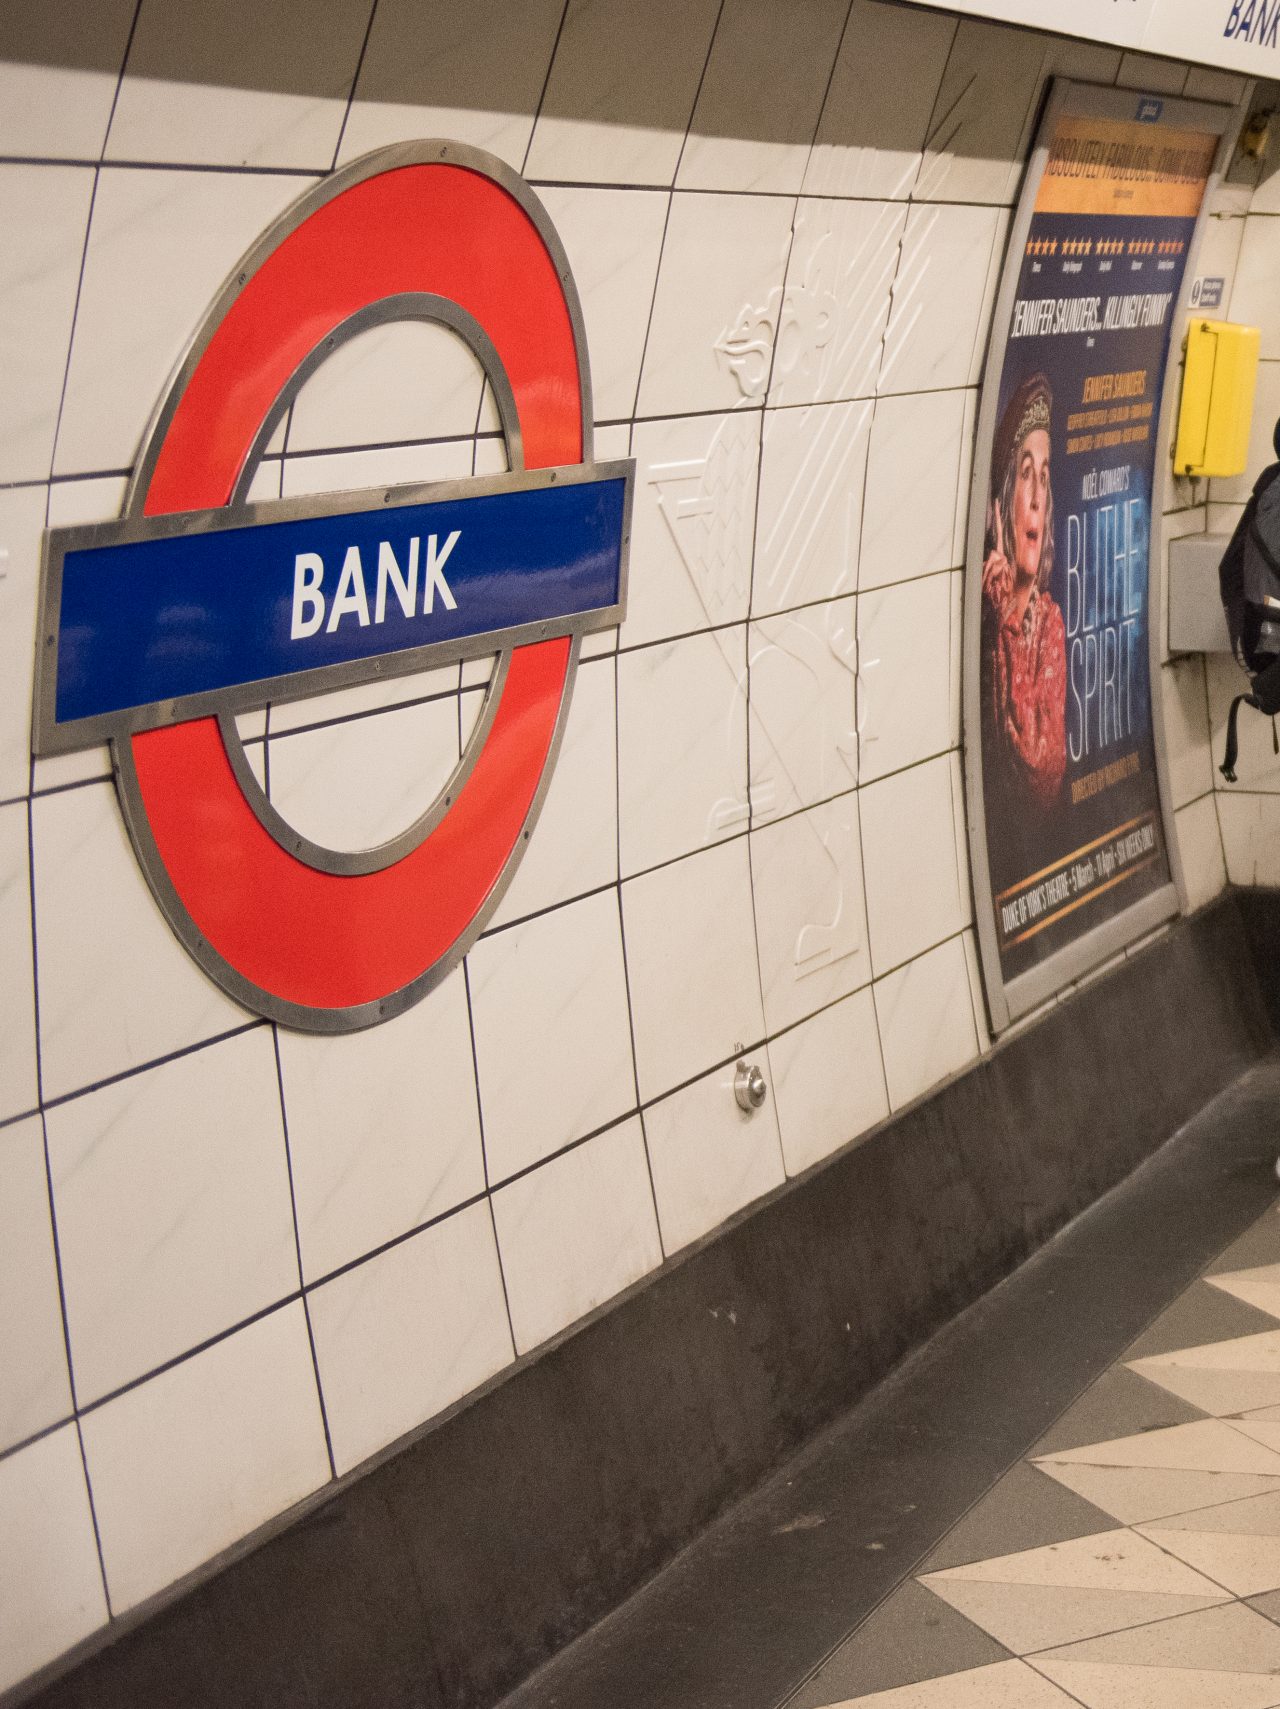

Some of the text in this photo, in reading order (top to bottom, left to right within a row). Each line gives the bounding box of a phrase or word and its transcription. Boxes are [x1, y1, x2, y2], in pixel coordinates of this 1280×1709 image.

[1102, 293, 1146, 330] KILLINGLY
[290, 530, 462, 640] BANK
[1066, 498, 1140, 638] BLITHE
[1069, 618, 1136, 762] SPIRIT
[1002, 900, 1020, 934] DUKE
[1018, 895, 1028, 925] OF
[1046, 871, 1070, 907] THEATRE
